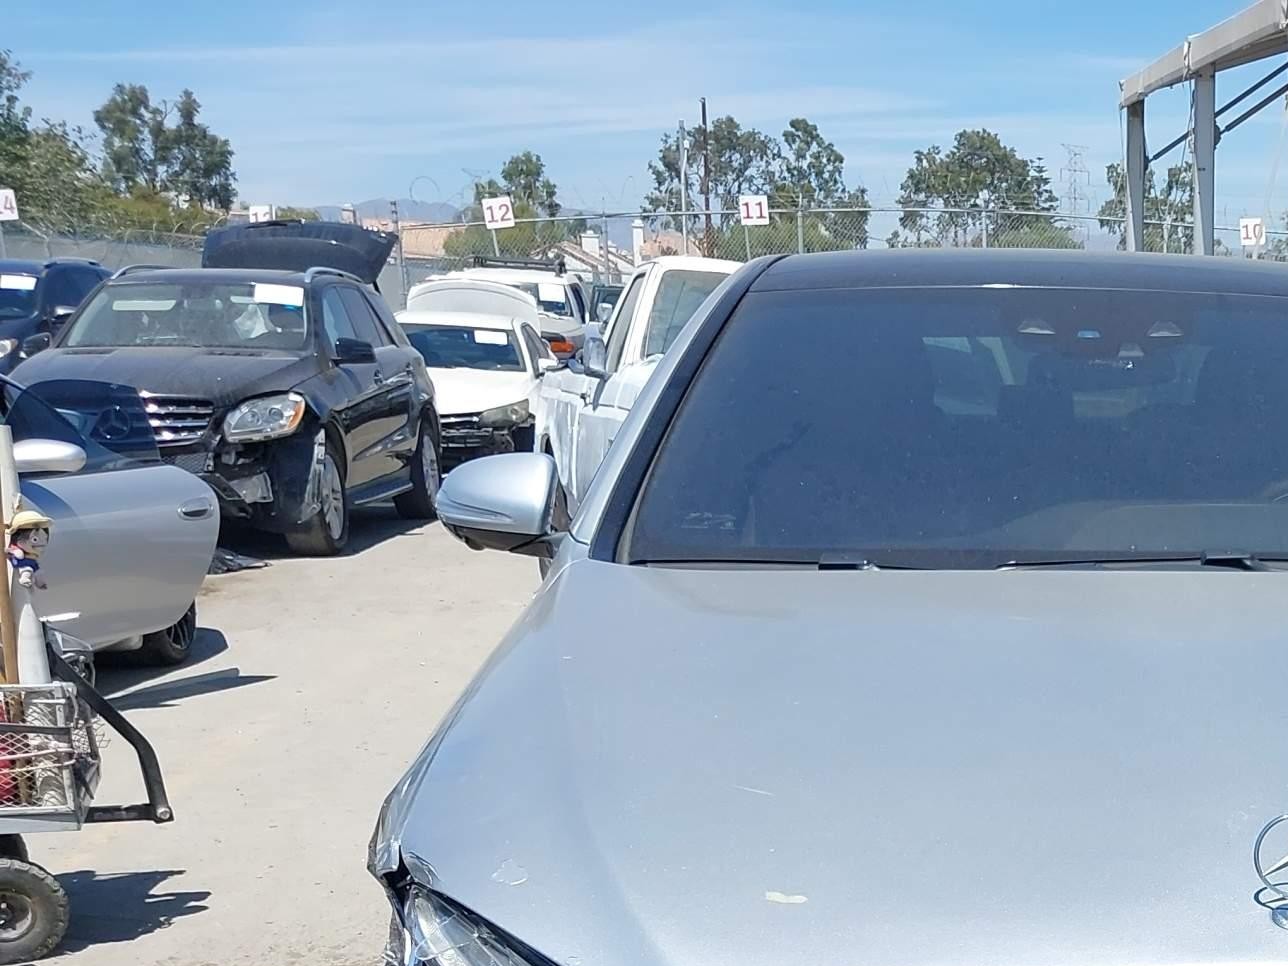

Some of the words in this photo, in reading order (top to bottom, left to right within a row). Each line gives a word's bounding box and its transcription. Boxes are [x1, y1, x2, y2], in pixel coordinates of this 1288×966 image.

[0, 195, 15, 214] 4
[486, 203, 511, 223] 12
[742, 201, 767, 219] 11
[1242, 223, 1263, 240] 10
